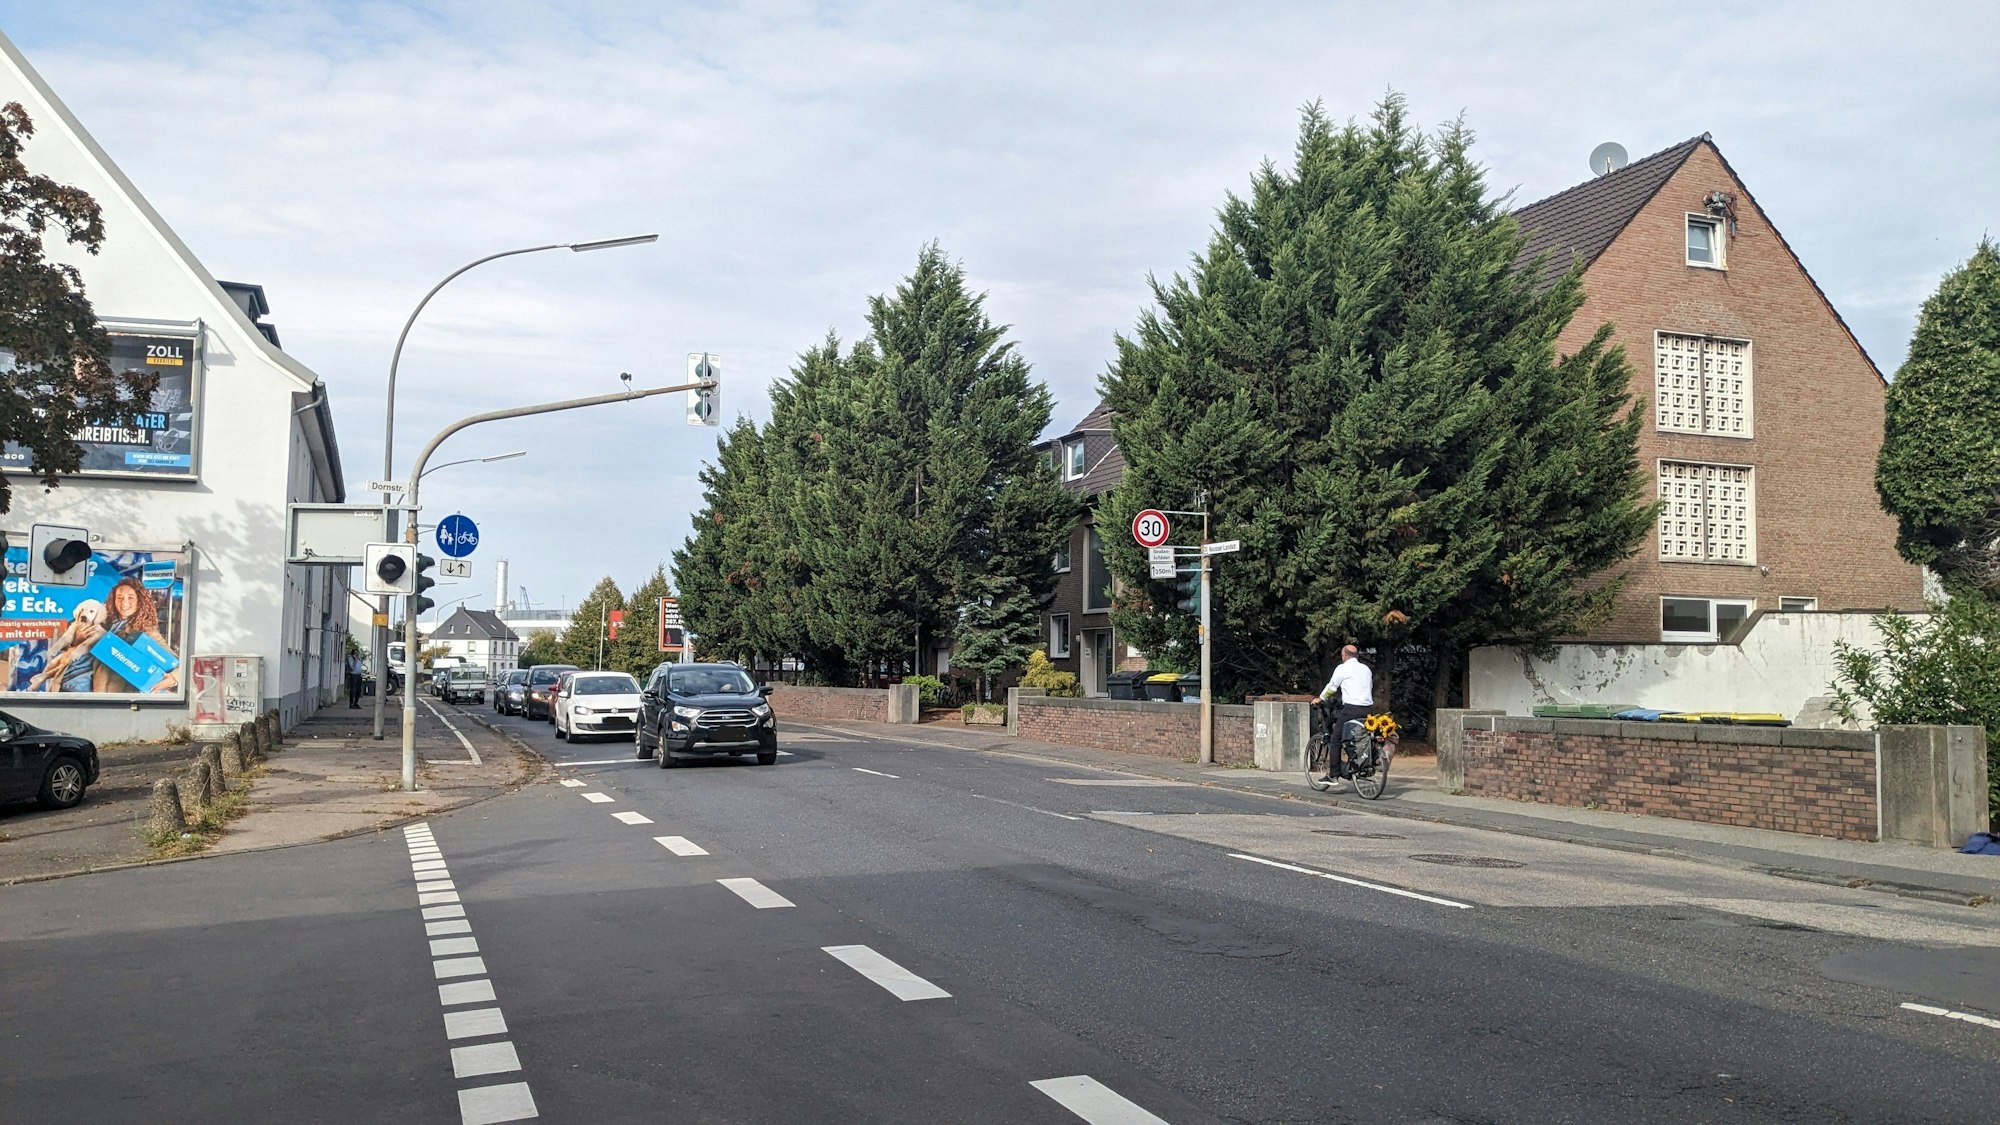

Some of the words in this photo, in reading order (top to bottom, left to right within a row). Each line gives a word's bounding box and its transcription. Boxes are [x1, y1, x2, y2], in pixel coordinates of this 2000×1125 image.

[146, 345, 183, 358] ZOLL
[372, 482, 404, 492] Dornstr.
[1141, 520, 1161, 537] 30
[3, 577, 39, 594] ekt
[22, 596, 64, 613] Eck.
[5, 629, 23, 638] mit
[25, 629, 46, 638] drin
[115, 651, 141, 673] Hermes
